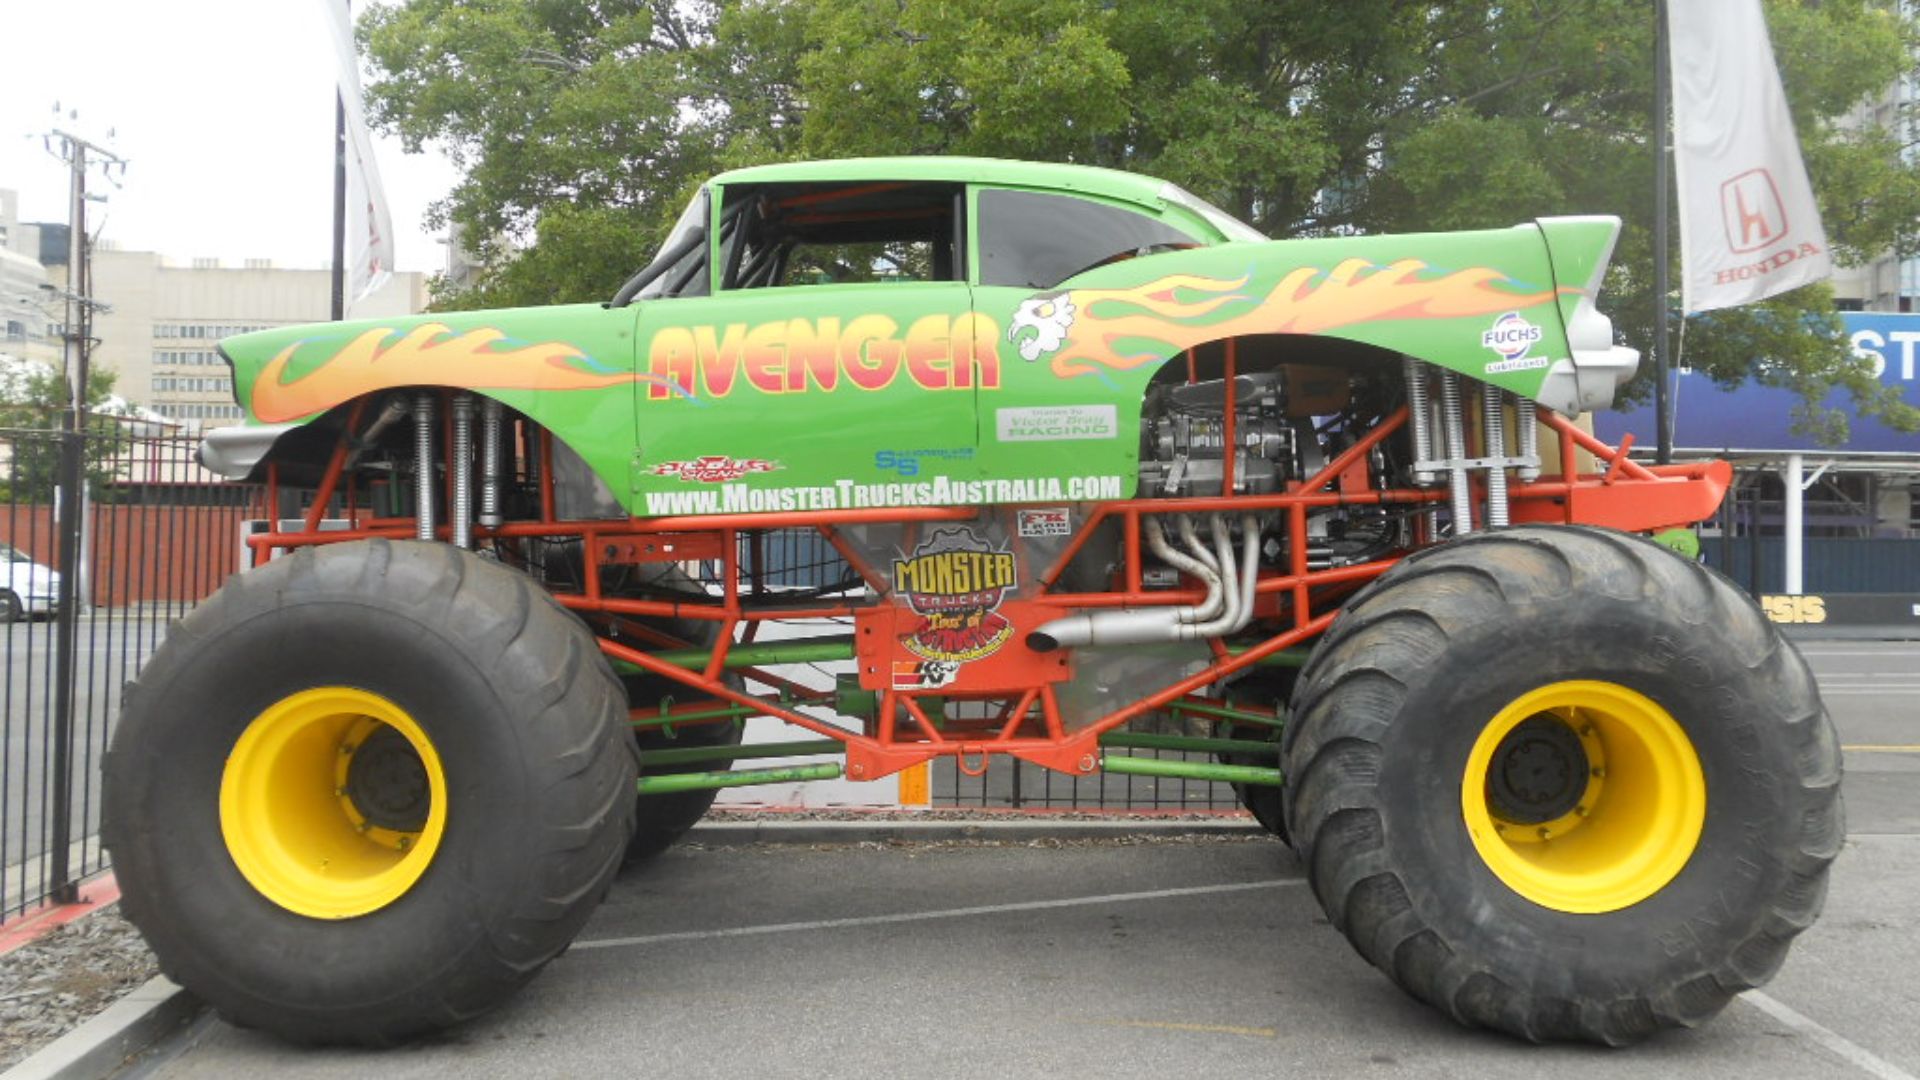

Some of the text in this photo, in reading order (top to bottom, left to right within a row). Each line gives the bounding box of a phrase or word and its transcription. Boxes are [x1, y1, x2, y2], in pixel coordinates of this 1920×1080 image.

[1713, 242, 1821, 285] HONDA
[1484, 327, 1539, 345] FUCHS
[649, 311, 1001, 401] AVENGER
[1008, 424, 1110, 437] RACING
[895, 552, 1013, 595] MONSTER
[917, 594, 995, 606] TRUCKS
